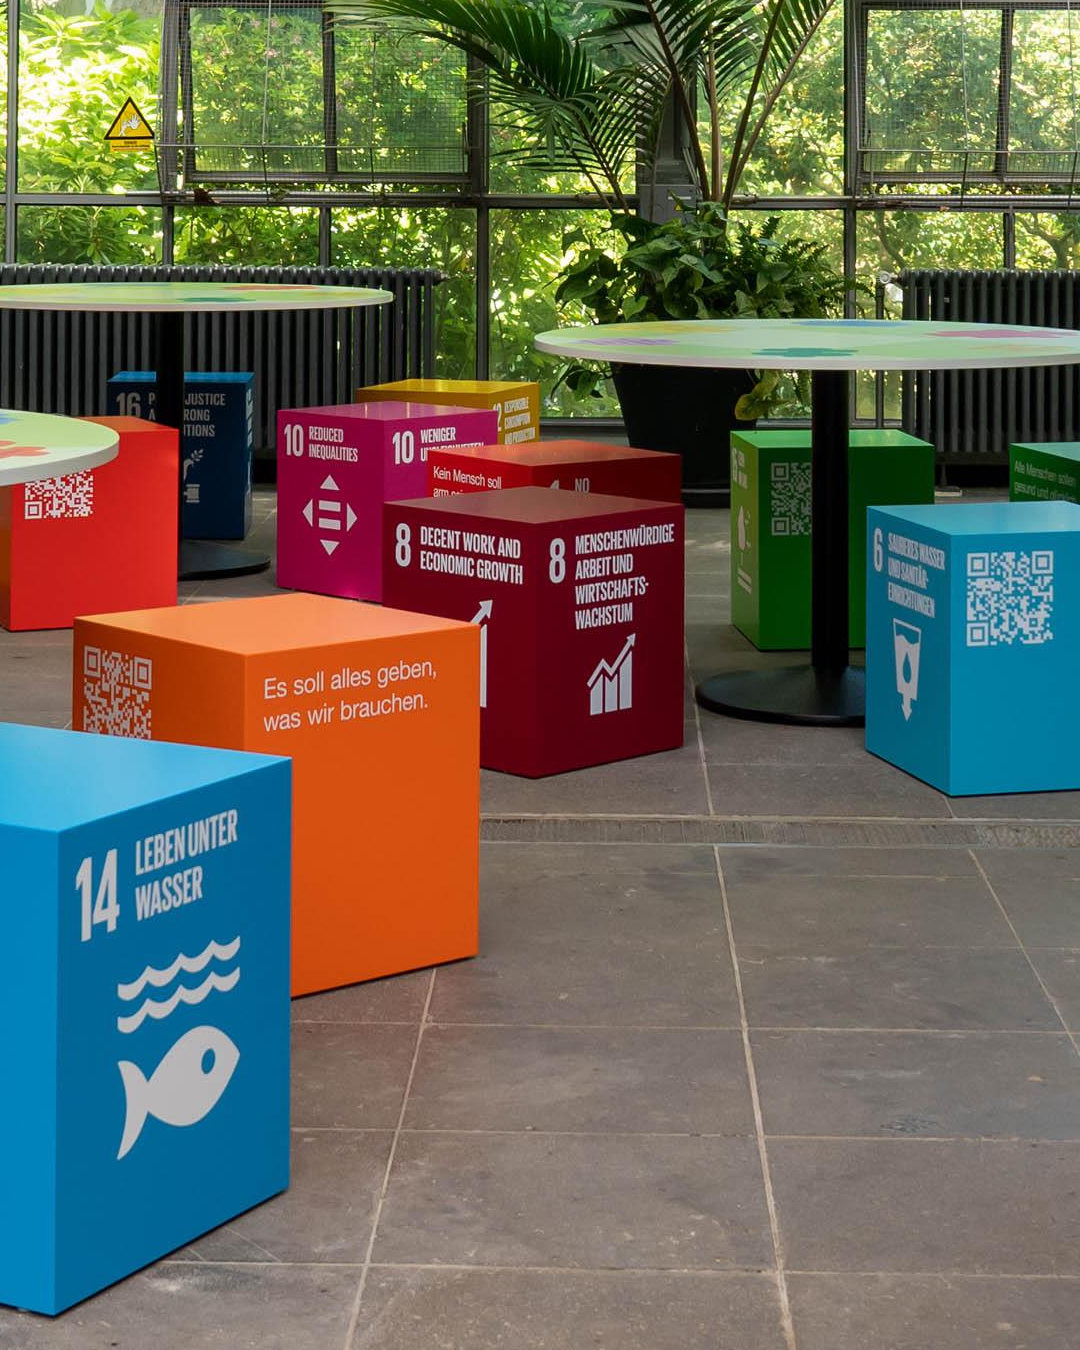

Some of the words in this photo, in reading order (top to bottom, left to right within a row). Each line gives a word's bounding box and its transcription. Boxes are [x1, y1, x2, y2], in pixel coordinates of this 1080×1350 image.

[116, 392, 141, 418] 16
[185, 393, 226, 406] JUSTICE
[284, 424, 304, 457] 10
[309, 425, 344, 443] REDUCED
[392, 430, 415, 465] 10
[420, 427, 456, 444] WENIGER
[308, 444, 358, 462] INEQUALITIES
[433, 466, 451, 481] Kein
[453, 469, 486, 487] Mensch
[487, 475, 502, 490] soll
[575, 477, 590, 494] NO
[395, 522, 412, 568] 8
[420, 526, 461, 551] DECENT
[463, 531, 496, 554] WORK
[497, 537, 521, 559] AND
[575, 523, 675, 555] MENSCHENWÜRDIGE
[874, 528, 883, 572] 6
[420, 550, 475, 577] ECONOMIC
[476, 559, 523, 585] GROWTH
[548, 537, 566, 584] 8
[575, 556, 612, 581] ARBEIT
[612, 553, 634, 575] UND
[575, 576, 649, 605] WIRTSCHAFTS-
[575, 602, 633, 630] WACHSTUM
[264, 677, 287, 700] Es
[293, 671, 325, 696] soll
[330, 668, 372, 691] alles
[377, 660, 437, 689] geben,
[264, 711, 301, 732] was
[308, 702, 335, 726] wir
[340, 693, 428, 722] brauchen.
[135, 825, 187, 877] LEBEN
[187, 808, 238, 858] UNTER
[75, 848, 120, 942] 14
[135, 865, 203, 922] WASSER
